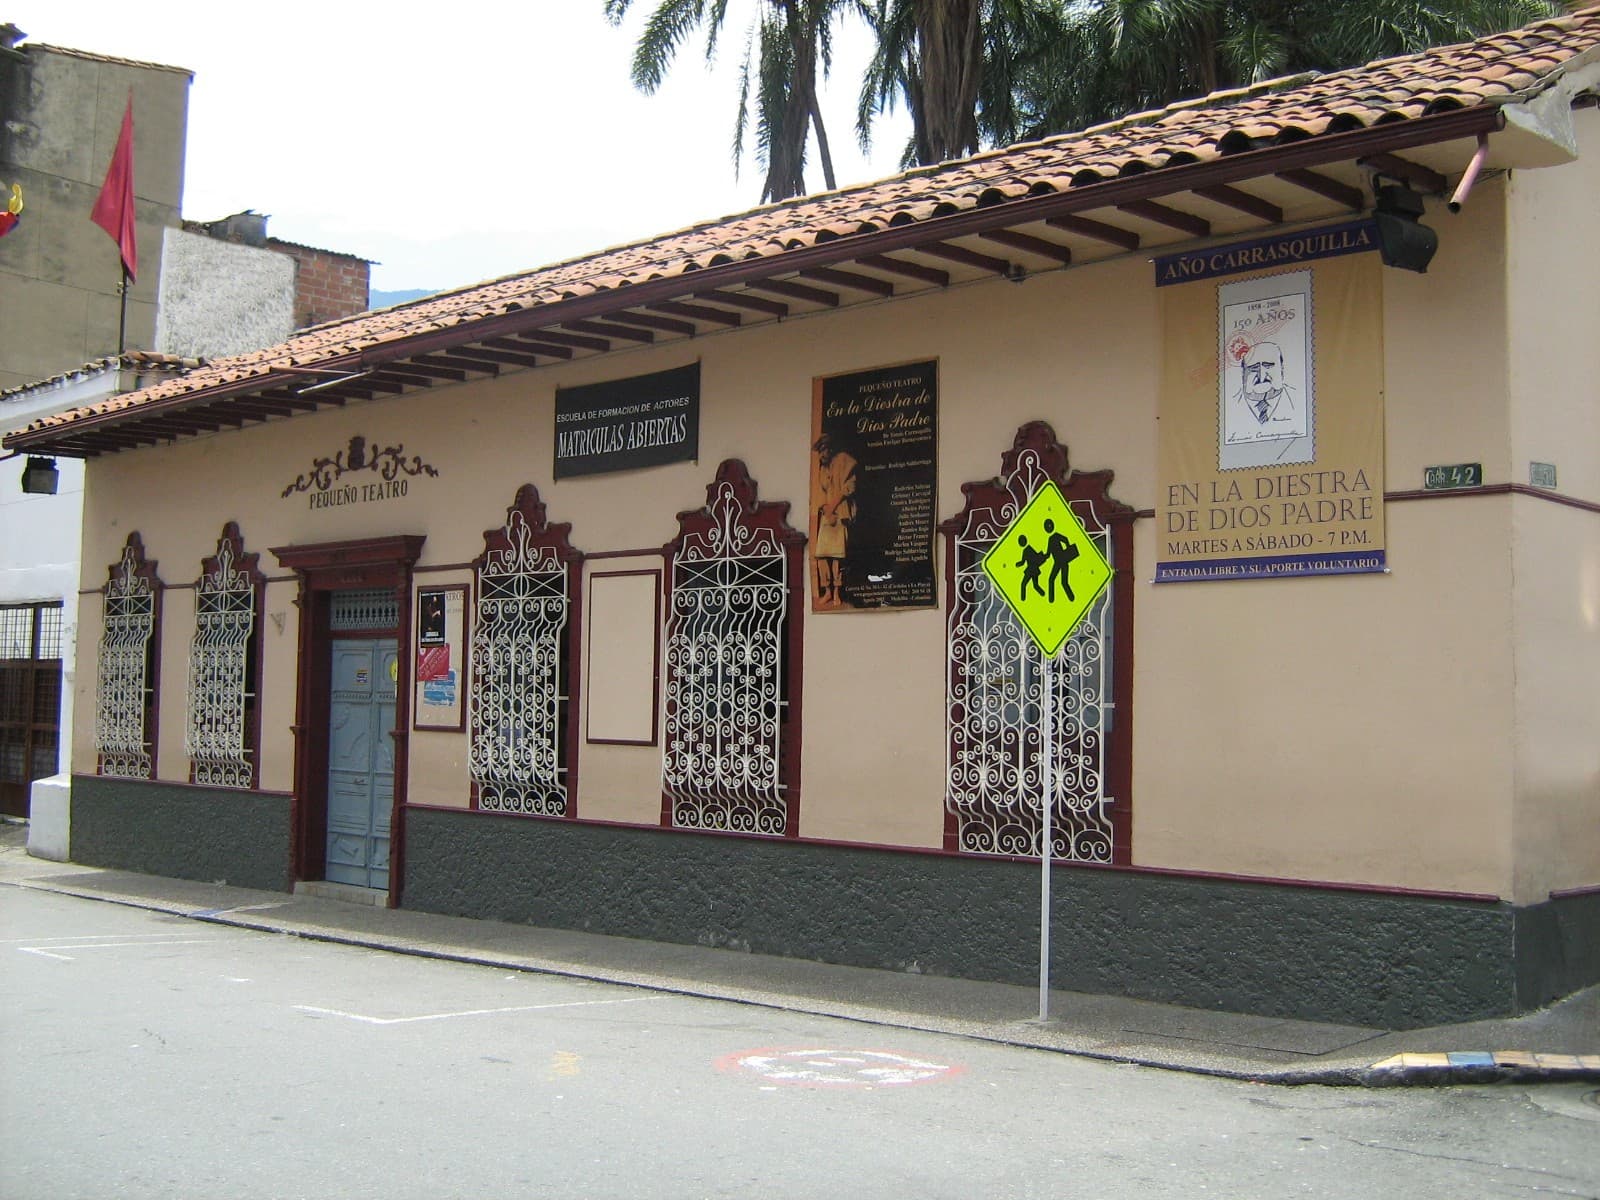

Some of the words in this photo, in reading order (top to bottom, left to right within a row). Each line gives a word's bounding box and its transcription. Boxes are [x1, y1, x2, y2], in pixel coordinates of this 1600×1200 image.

[1164, 256, 1205, 280] AÑO
[1209, 228, 1371, 271] CARRASQUILLA
[1233, 318, 1252, 330] 150
[1256, 308, 1295, 325] AÑOS
[859, 380, 892, 393] PEQUEÑO
[893, 377, 922, 388] TEATRO
[556, 411, 587, 423] ESCUELA
[587, 409, 597, 420] DE
[598, 404, 640, 417] FORMACION
[641, 402, 651, 413] DE
[653, 396, 690, 410] ACTORES
[826, 401, 844, 418] En
[847, 399, 860, 415] la
[864, 393, 912, 412] Diestra
[914, 388, 930, 405] de
[557, 423, 625, 458] MATRICULAS
[627, 413, 688, 450] ABIERTAS
[856, 416, 885, 434] Dios
[888, 410, 930, 429] Padre
[309, 484, 357, 510] PEQUEÑO
[362, 479, 408, 503] TEATRO
[1167, 482, 1200, 507] EN
[1210, 479, 1243, 503] LA
[1255, 468, 1371, 500] DIESTRA
[1167, 510, 1200, 533] DE
[1208, 504, 1271, 531] DIOS
[1281, 496, 1374, 526] PADRE
[1167, 538, 1229, 556] MARTES
[1231, 538, 1242, 552] A
[1246, 532, 1314, 551] SÁBADO
[1327, 531, 1336, 546] 7
[1340, 529, 1372, 545] P.M.
[1162, 566, 1209, 578] ENTRADA
[1210, 565, 1239, 576] LIBRE
[1240, 565, 1248, 574] Y
[1248, 563, 1262, 574] SU
[1264, 561, 1306, 573] APORTE
[1307, 557, 1380, 571] VOLUNTARIO
